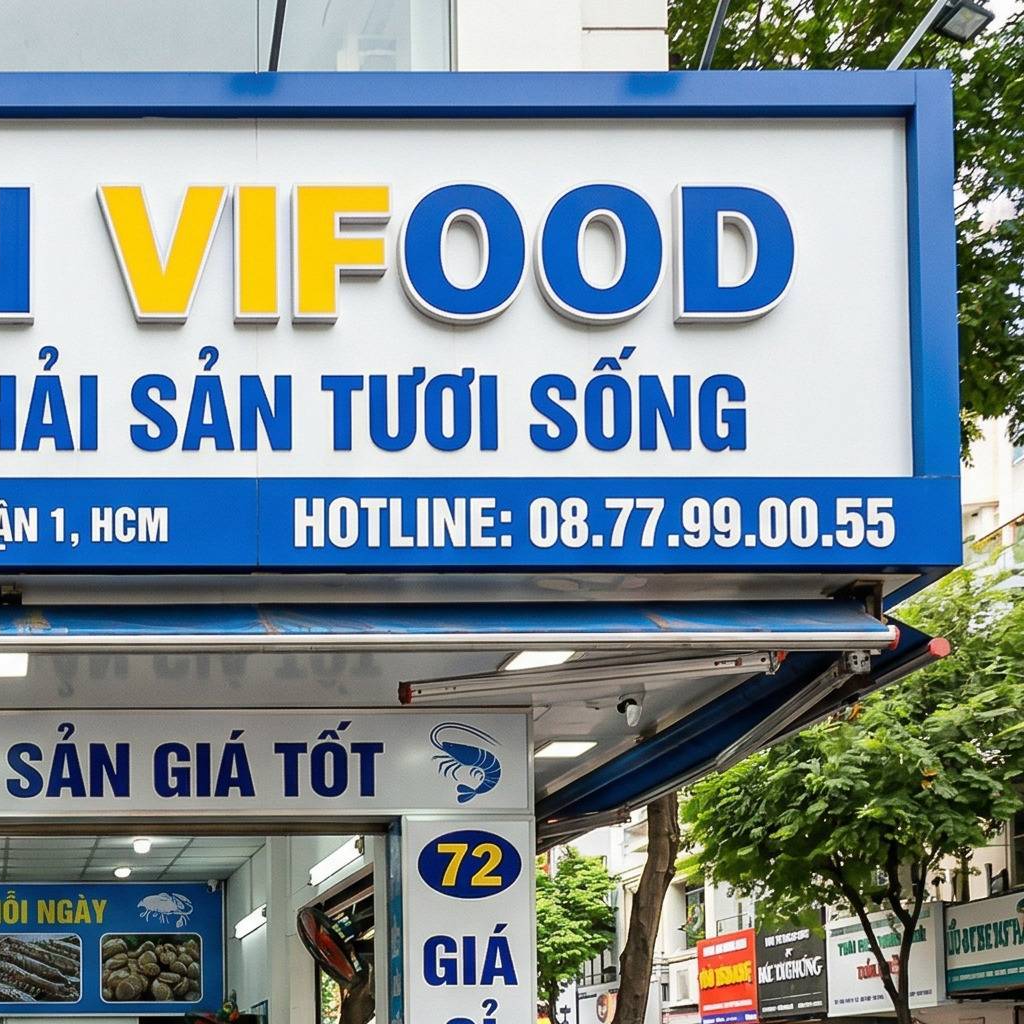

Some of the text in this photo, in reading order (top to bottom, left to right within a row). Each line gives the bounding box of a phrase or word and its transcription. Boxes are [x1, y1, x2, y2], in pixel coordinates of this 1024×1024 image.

[99, 183, 795, 319] VIFOOD
[129, 345, 293, 453] SẢN
[320, 366, 499, 453] TƯƠI
[529, 346, 747, 453] SỐNG
[50, 507, 79, 548] 1,
[91, 506, 168, 543] HCM
[293, 496, 896, 549] HOTLINE: 08.77.99.00.55
[5, 722, 131, 799] SẢN
[153, 729, 255, 799] GIÁ
[274, 721, 384, 798] TỐT
[436, 842, 503, 887] 72
[36, 893, 108, 926] NGÀY
[423, 923, 518, 987] GIÁ
